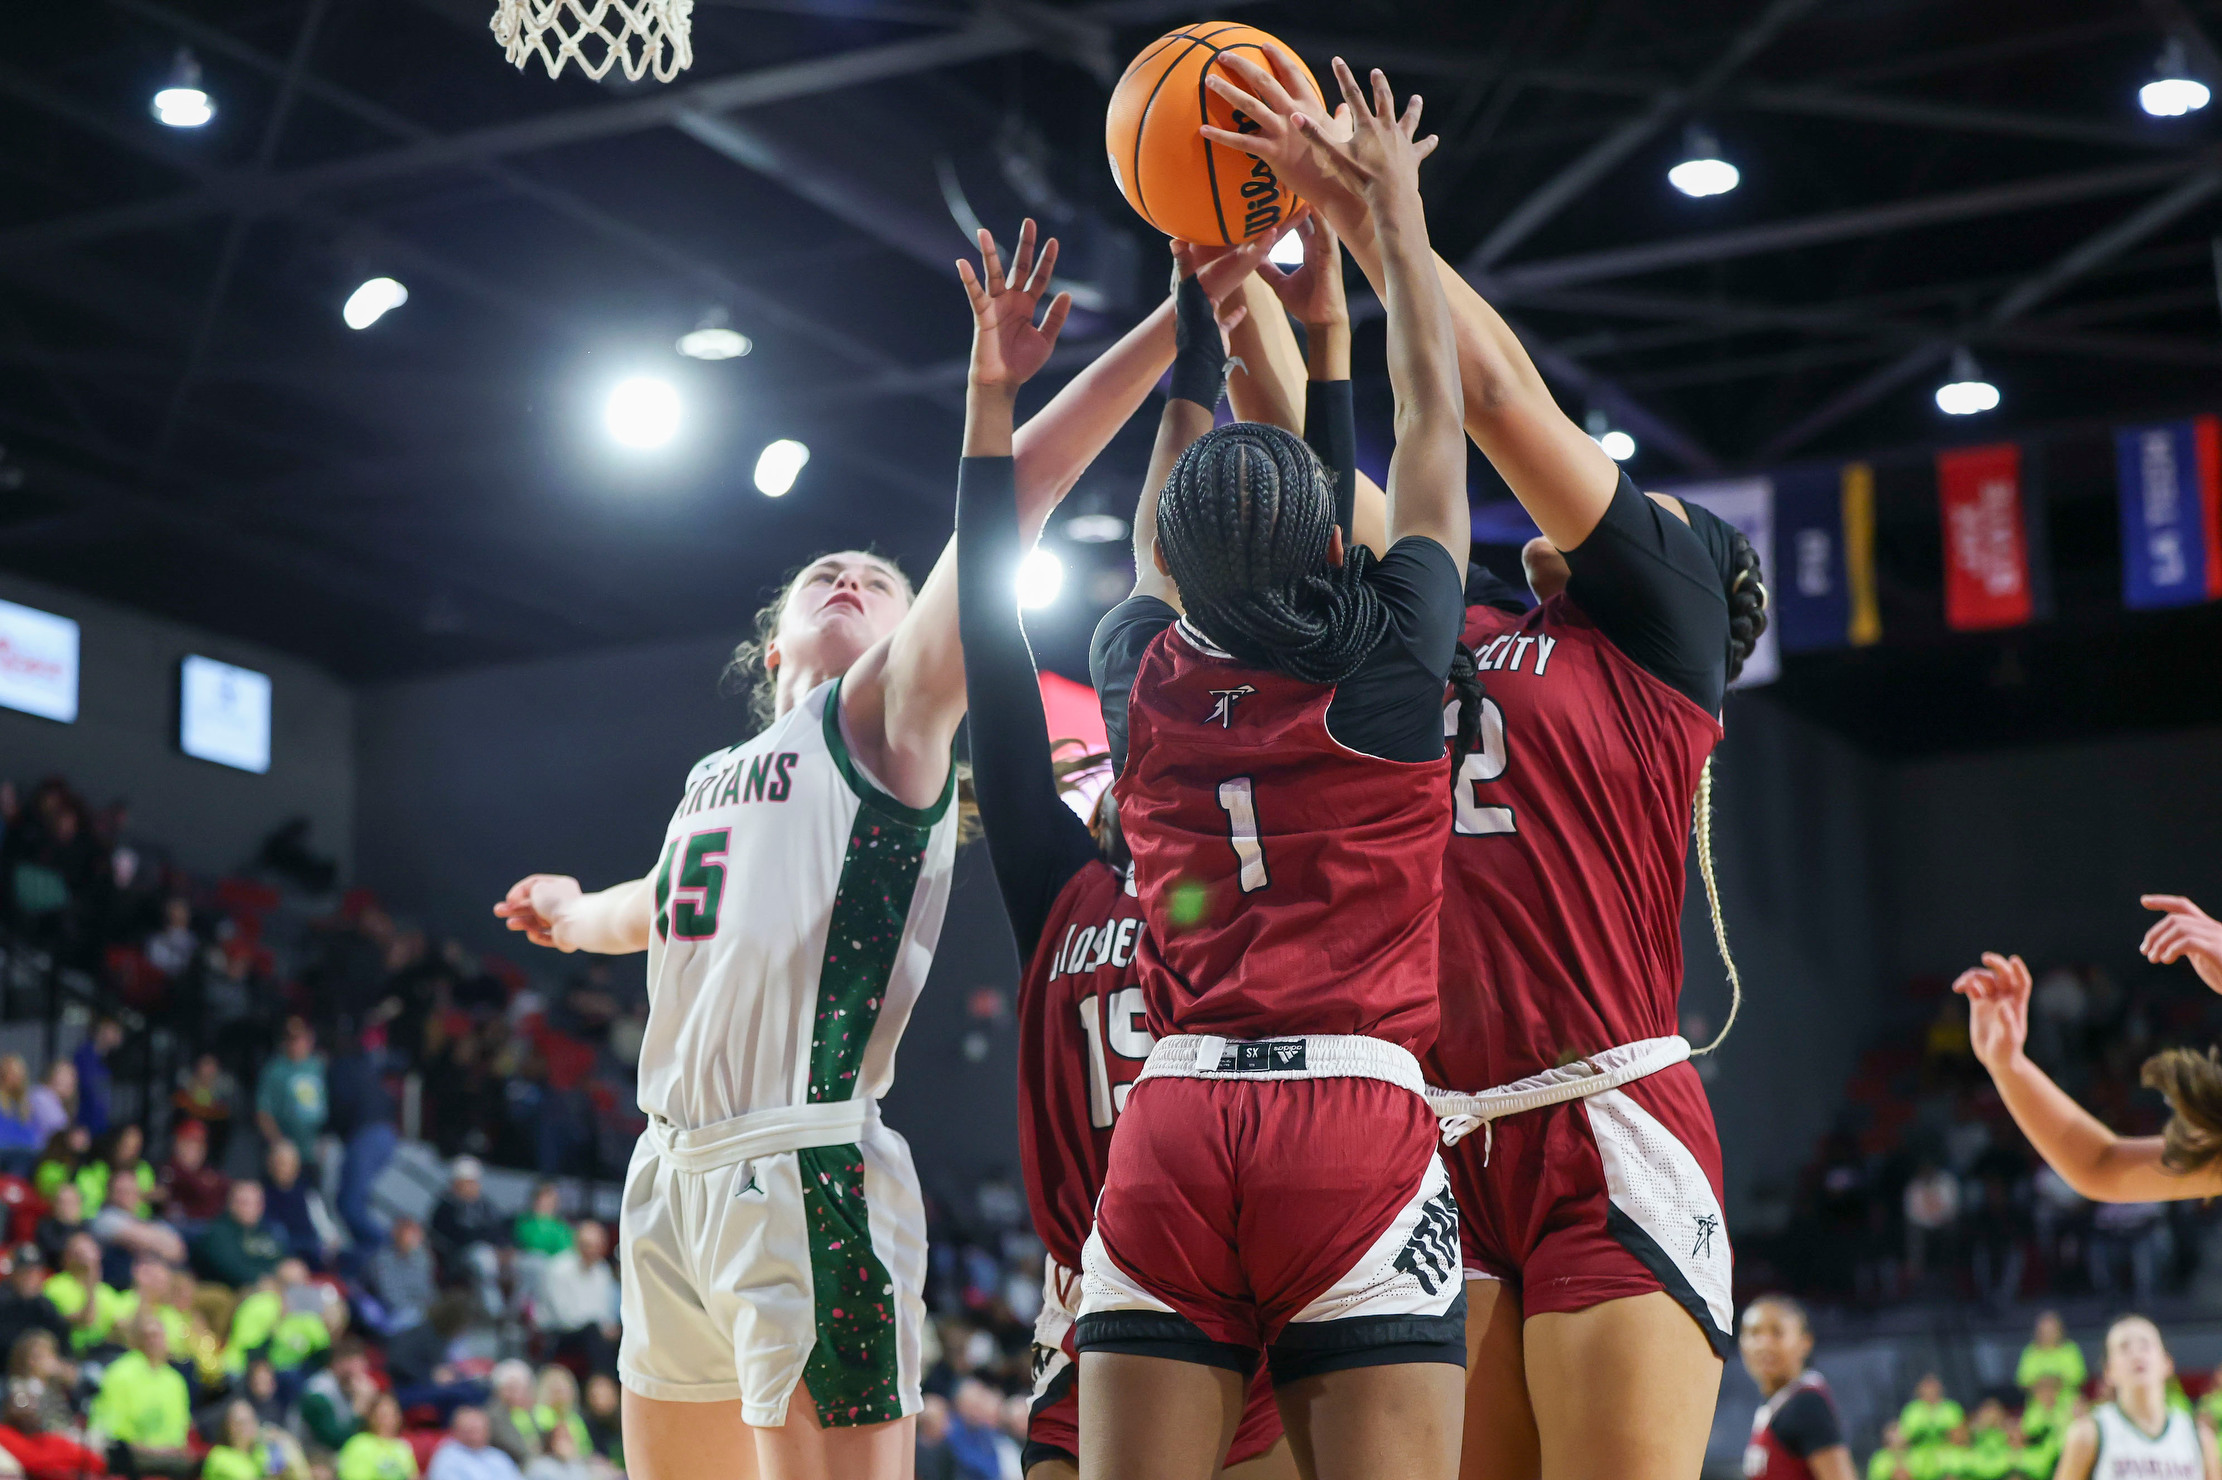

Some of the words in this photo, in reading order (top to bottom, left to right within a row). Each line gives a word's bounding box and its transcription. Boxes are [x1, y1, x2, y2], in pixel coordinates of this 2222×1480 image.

[1231, 108, 1281, 239] Wilsn
[1444, 697, 1517, 834] 2
[655, 826, 732, 945] 15
[1219, 777, 1269, 893] 1
[1246, 1047, 1259, 1058] XS
